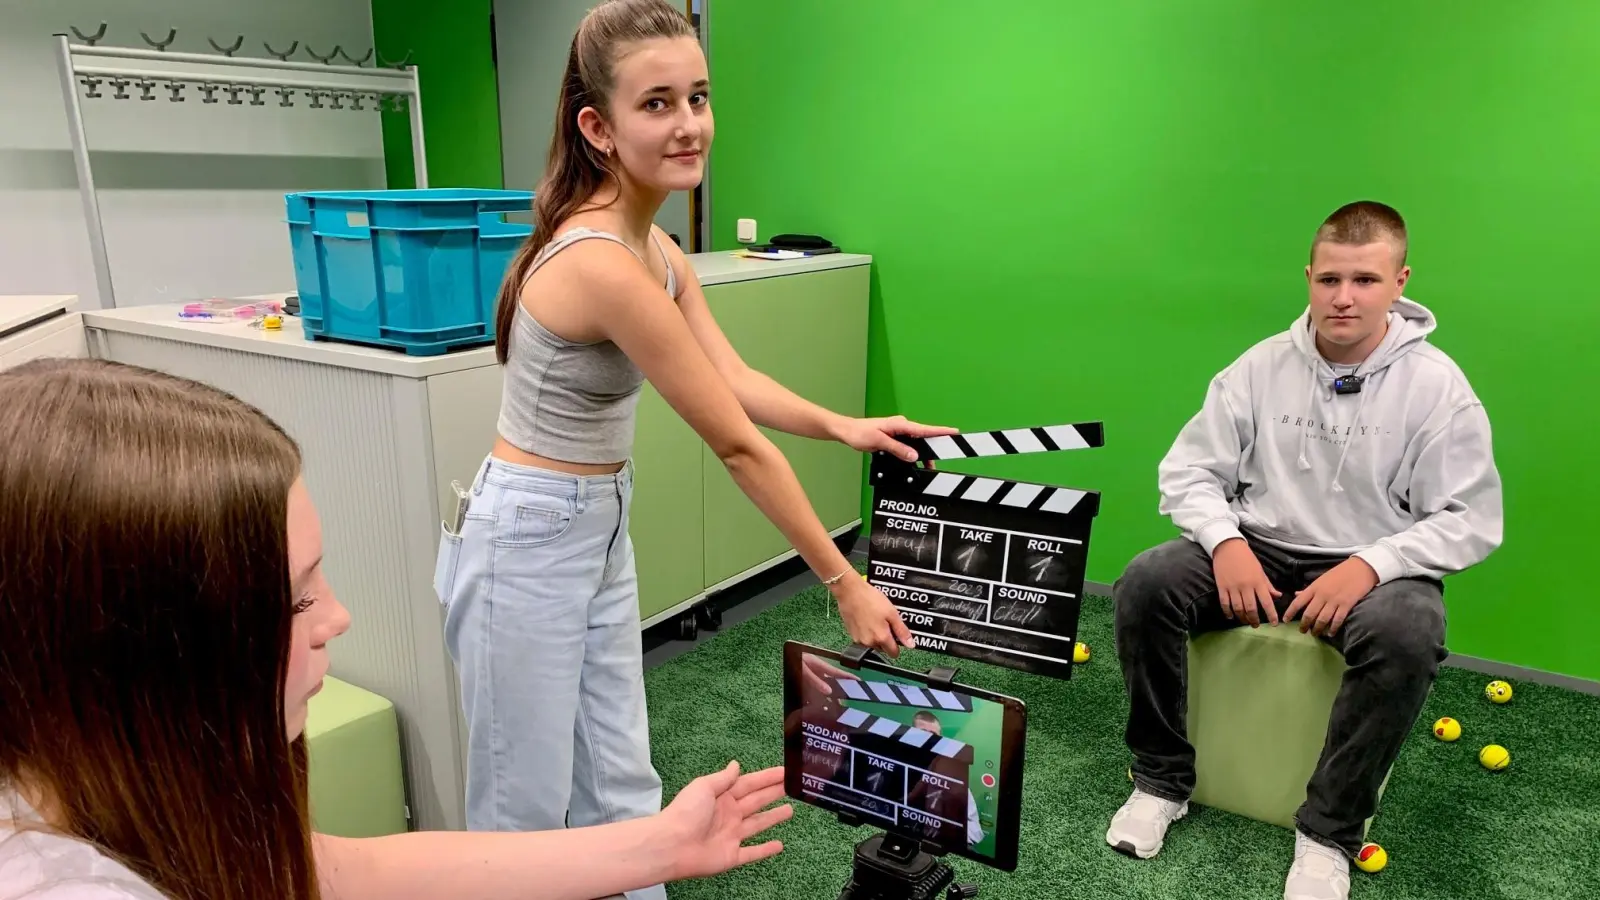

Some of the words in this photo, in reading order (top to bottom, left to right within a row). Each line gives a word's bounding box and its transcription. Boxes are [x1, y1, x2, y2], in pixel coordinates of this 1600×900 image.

[879, 499, 939, 517] PROD.NO.
[886, 518, 929, 533] SCENE
[959, 529, 994, 543] TAKE
[1027, 539, 1064, 554] ROLL
[957, 545, 978, 572] 1
[874, 566, 907, 580] DATE
[1030, 556, 1054, 582] 1
[948, 579, 983, 598] 2023
[998, 587, 1047, 604] SOUND
[898, 611, 934, 626] CTOR
[806, 738, 843, 755] SCENE
[867, 756, 895, 772] TAKE
[921, 774, 951, 790] ROLL
[902, 809, 942, 828] SOUND
